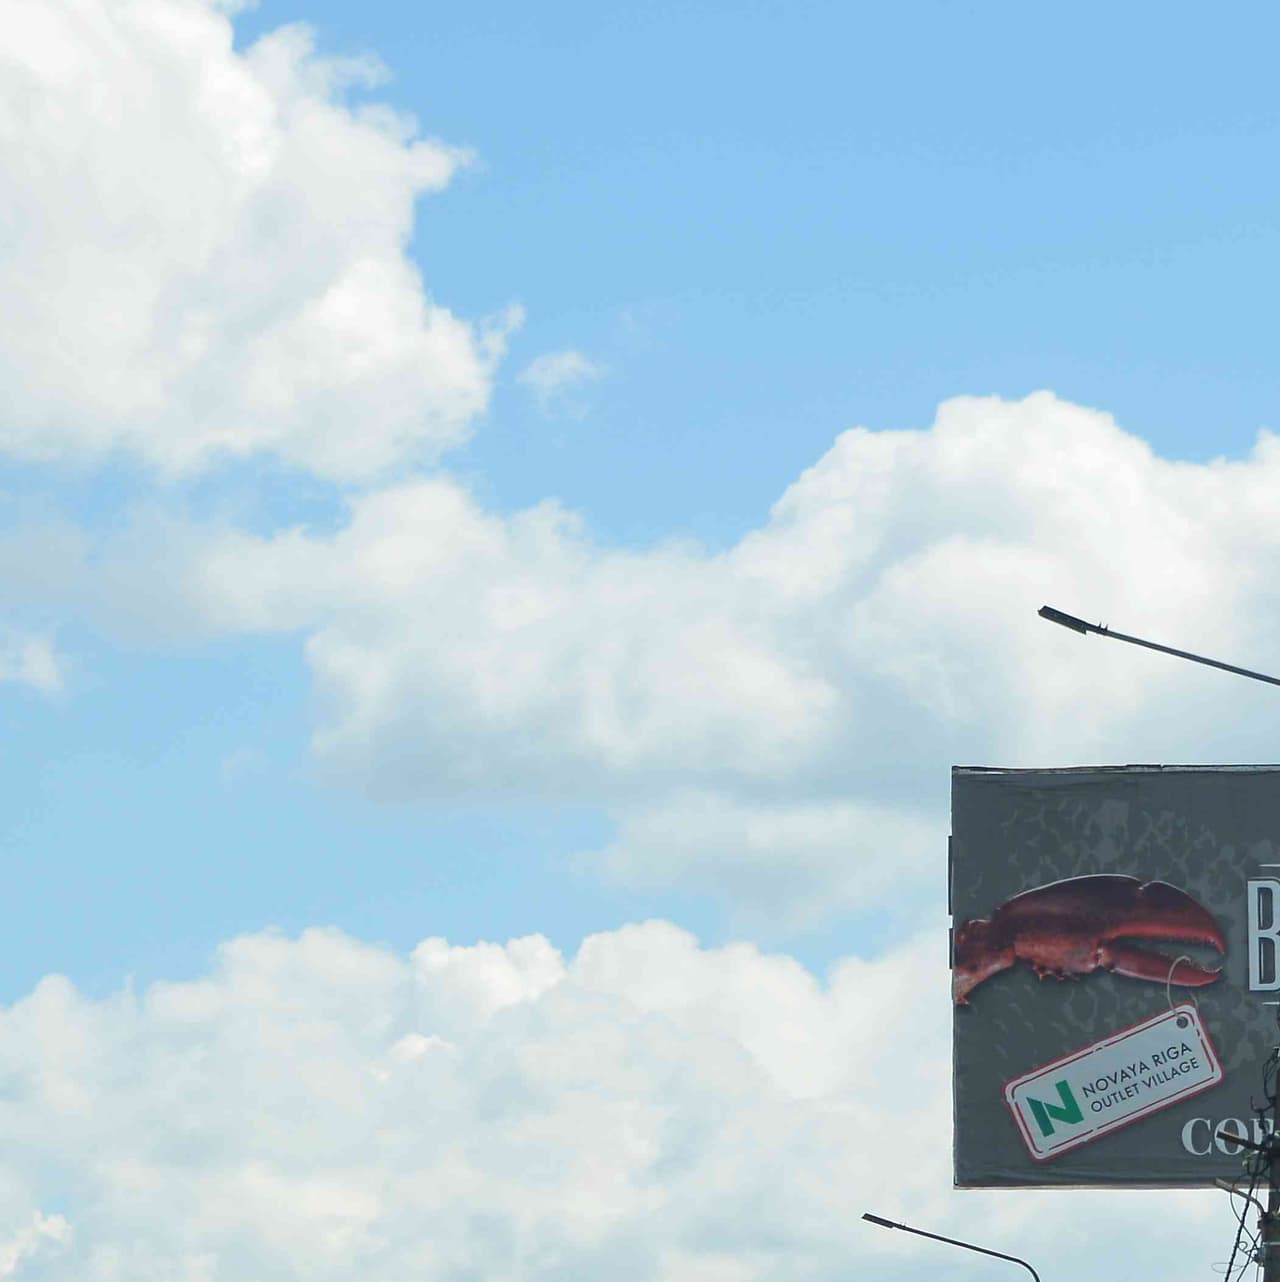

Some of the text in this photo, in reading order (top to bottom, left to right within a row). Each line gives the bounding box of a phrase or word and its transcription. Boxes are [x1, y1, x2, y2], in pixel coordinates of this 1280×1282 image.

[1082, 1042, 1192, 1098] NOVAYA RIGA
[1091, 1058, 1199, 1112] OUTLET VILLAGE
